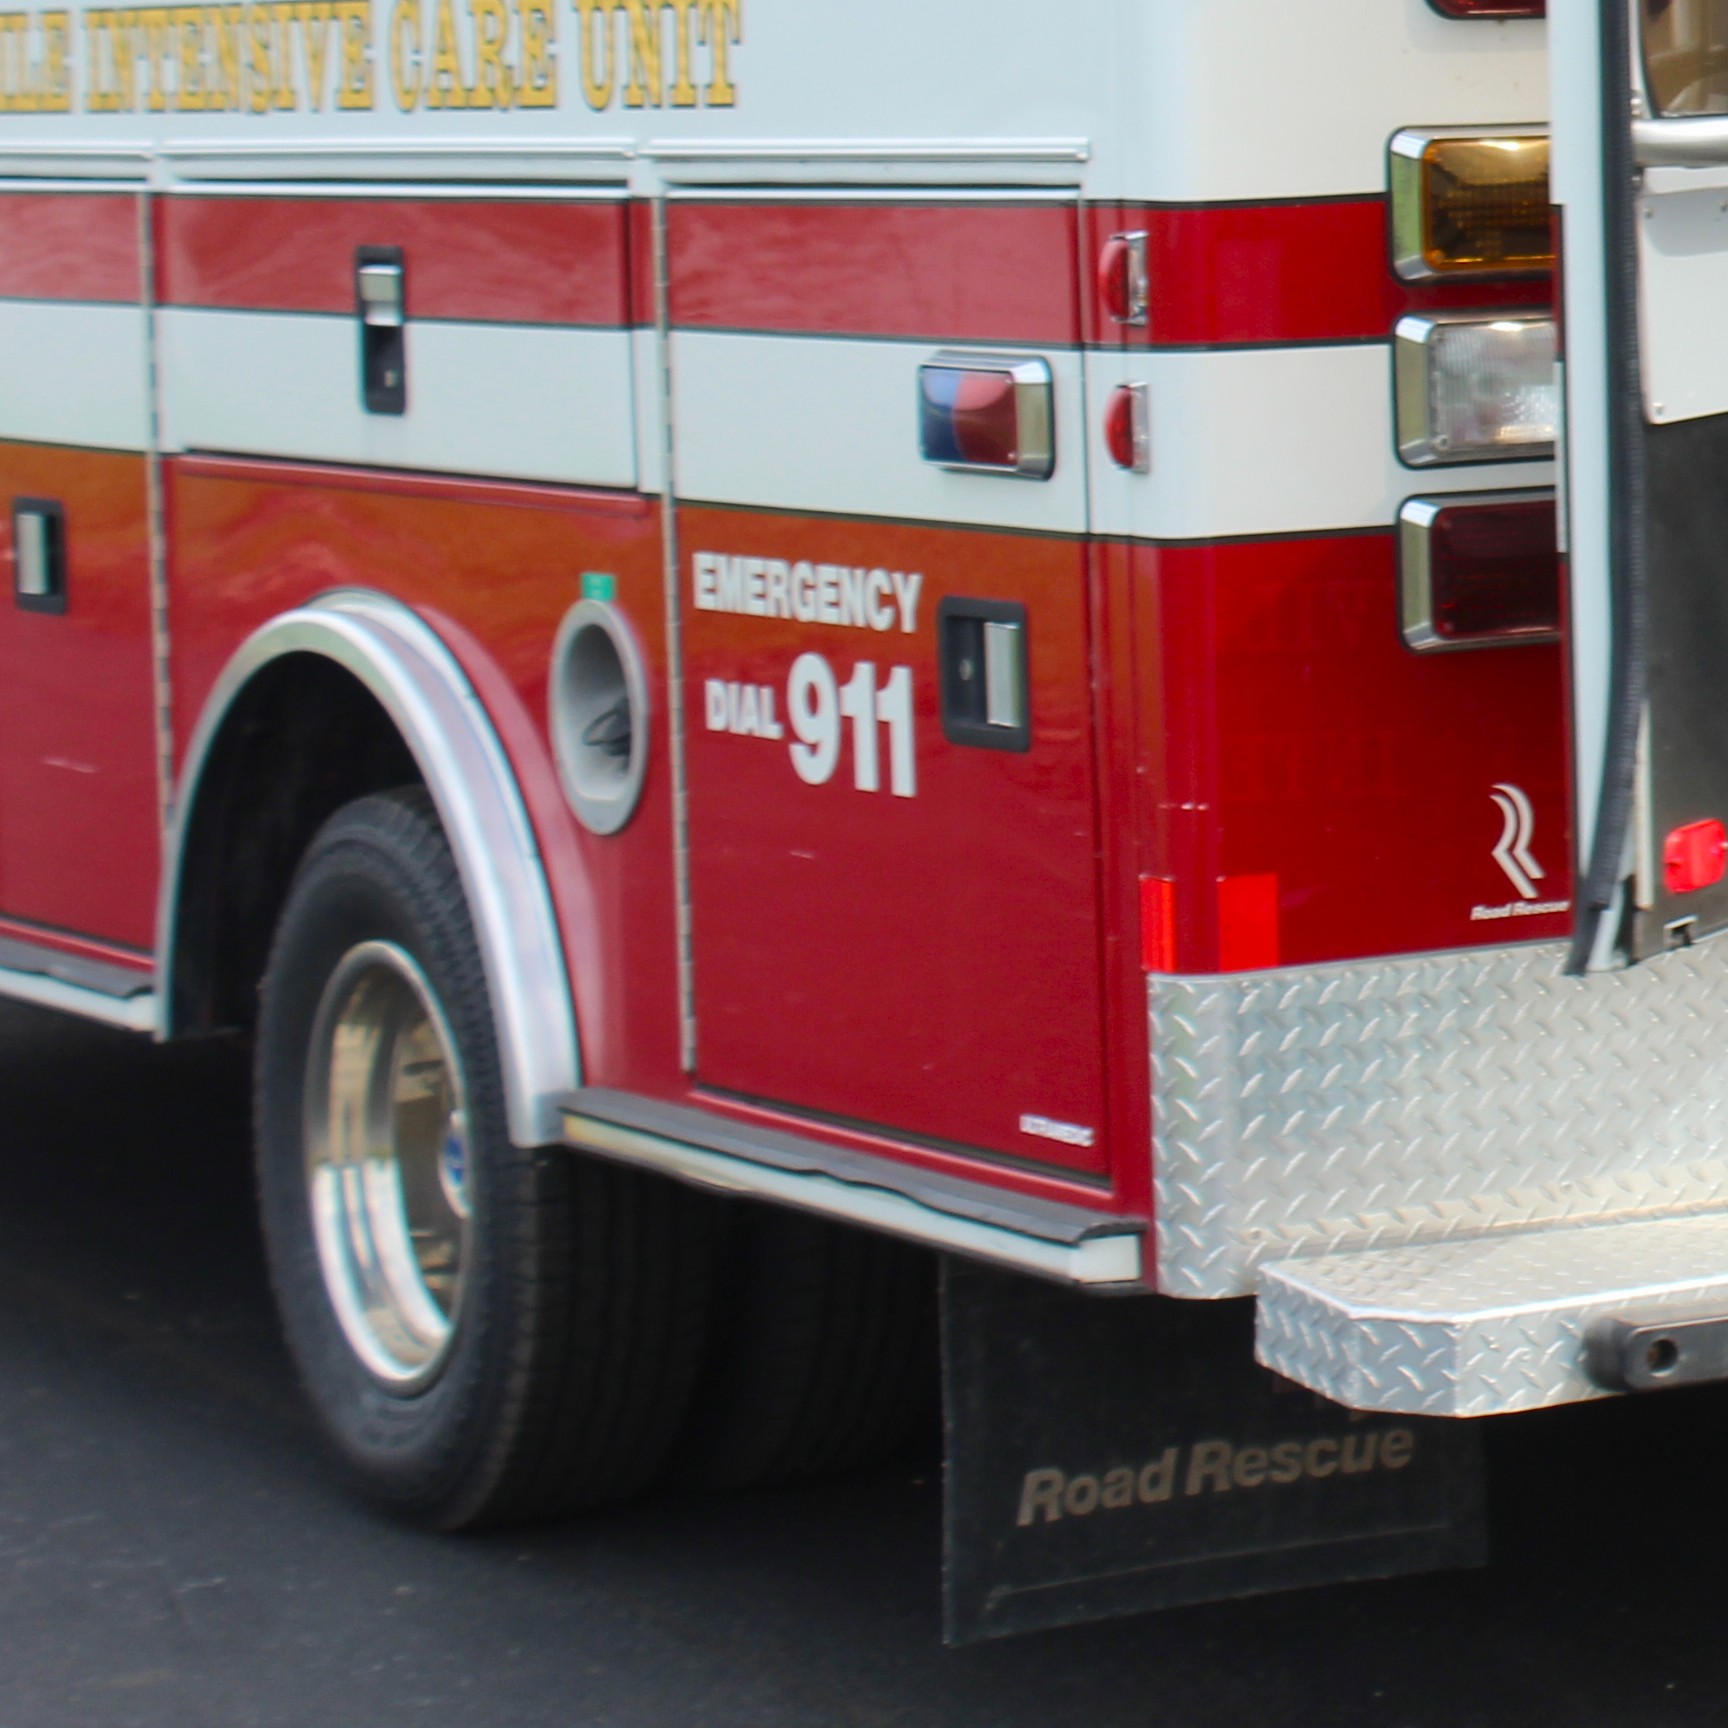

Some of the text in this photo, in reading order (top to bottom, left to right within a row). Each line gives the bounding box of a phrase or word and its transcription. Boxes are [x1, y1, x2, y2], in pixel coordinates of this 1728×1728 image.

[693, 551, 922, 633] EMERGENCY
[704, 651, 917, 799] DIAL 911
[1016, 1428, 1414, 1528] Road Rescue
